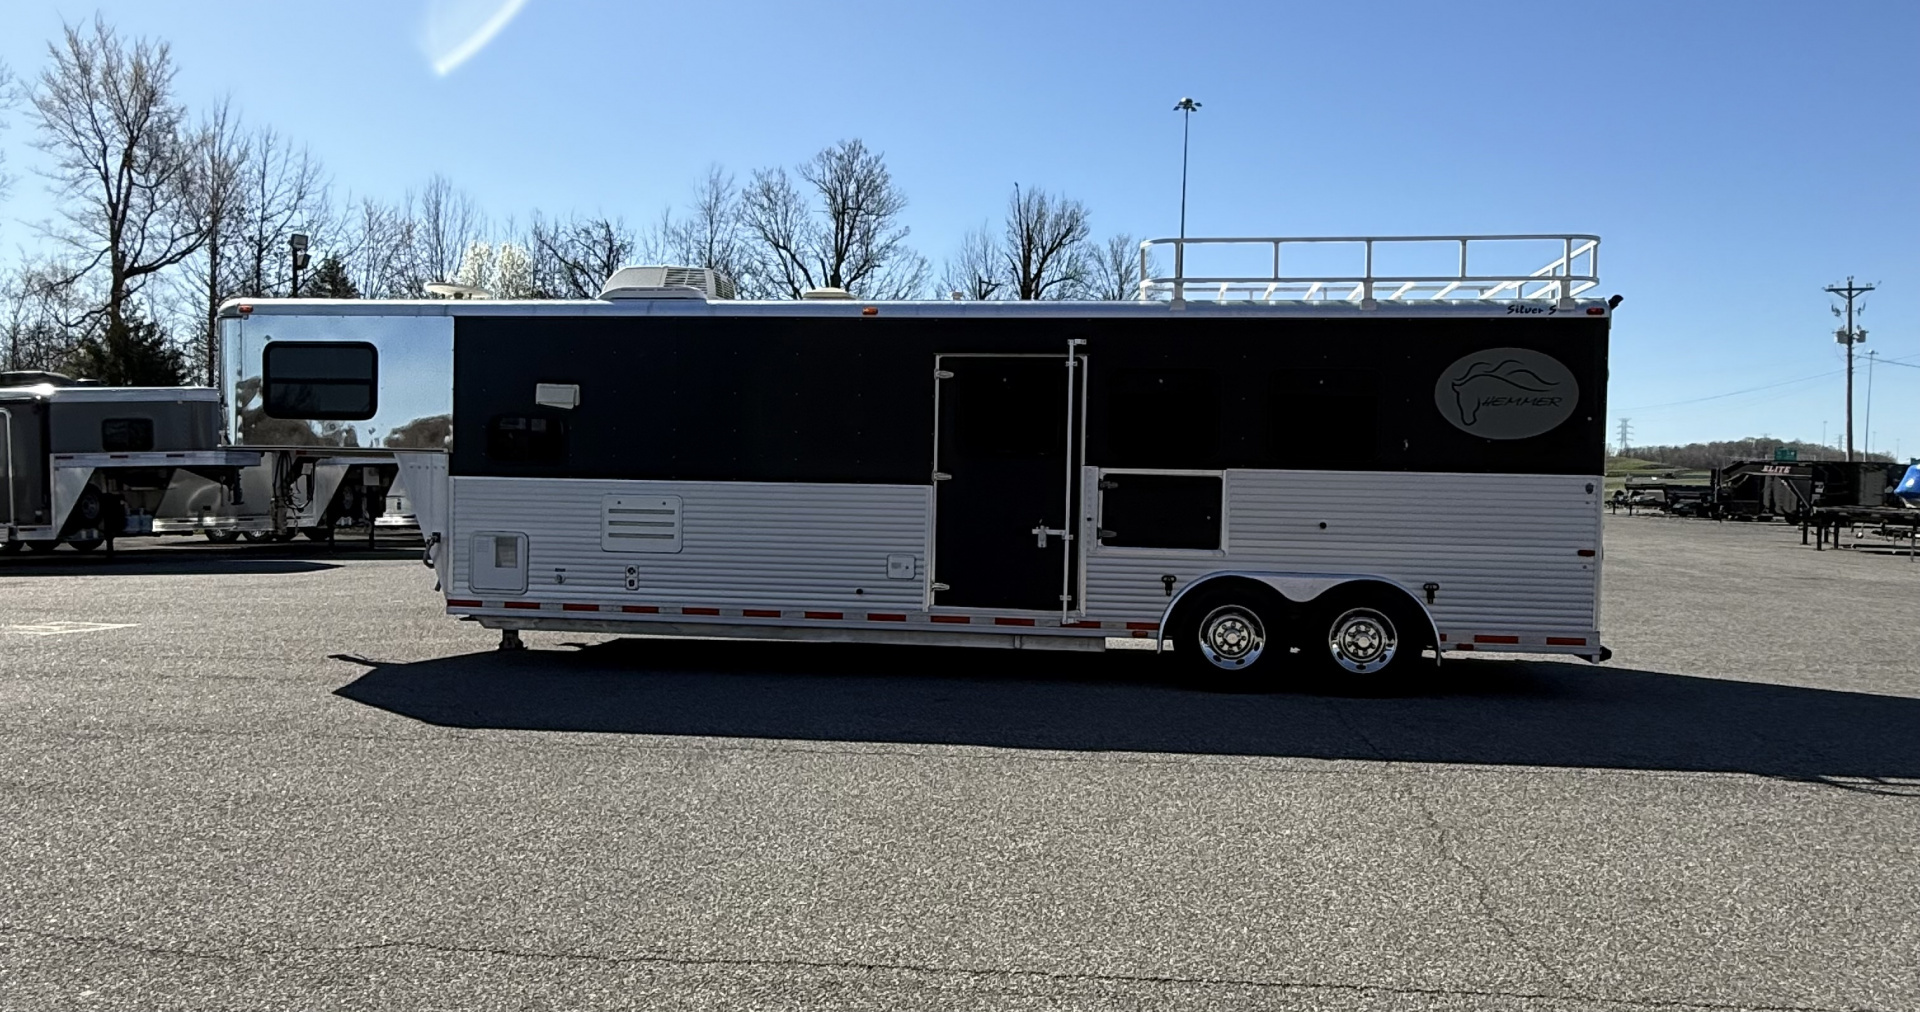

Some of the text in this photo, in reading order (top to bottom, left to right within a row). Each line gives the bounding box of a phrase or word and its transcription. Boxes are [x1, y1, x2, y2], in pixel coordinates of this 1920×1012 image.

[1507, 304, 1557, 315] Silver S
[1482, 396, 1562, 407] HEMMER
[1761, 465, 1791, 474] ELITE
